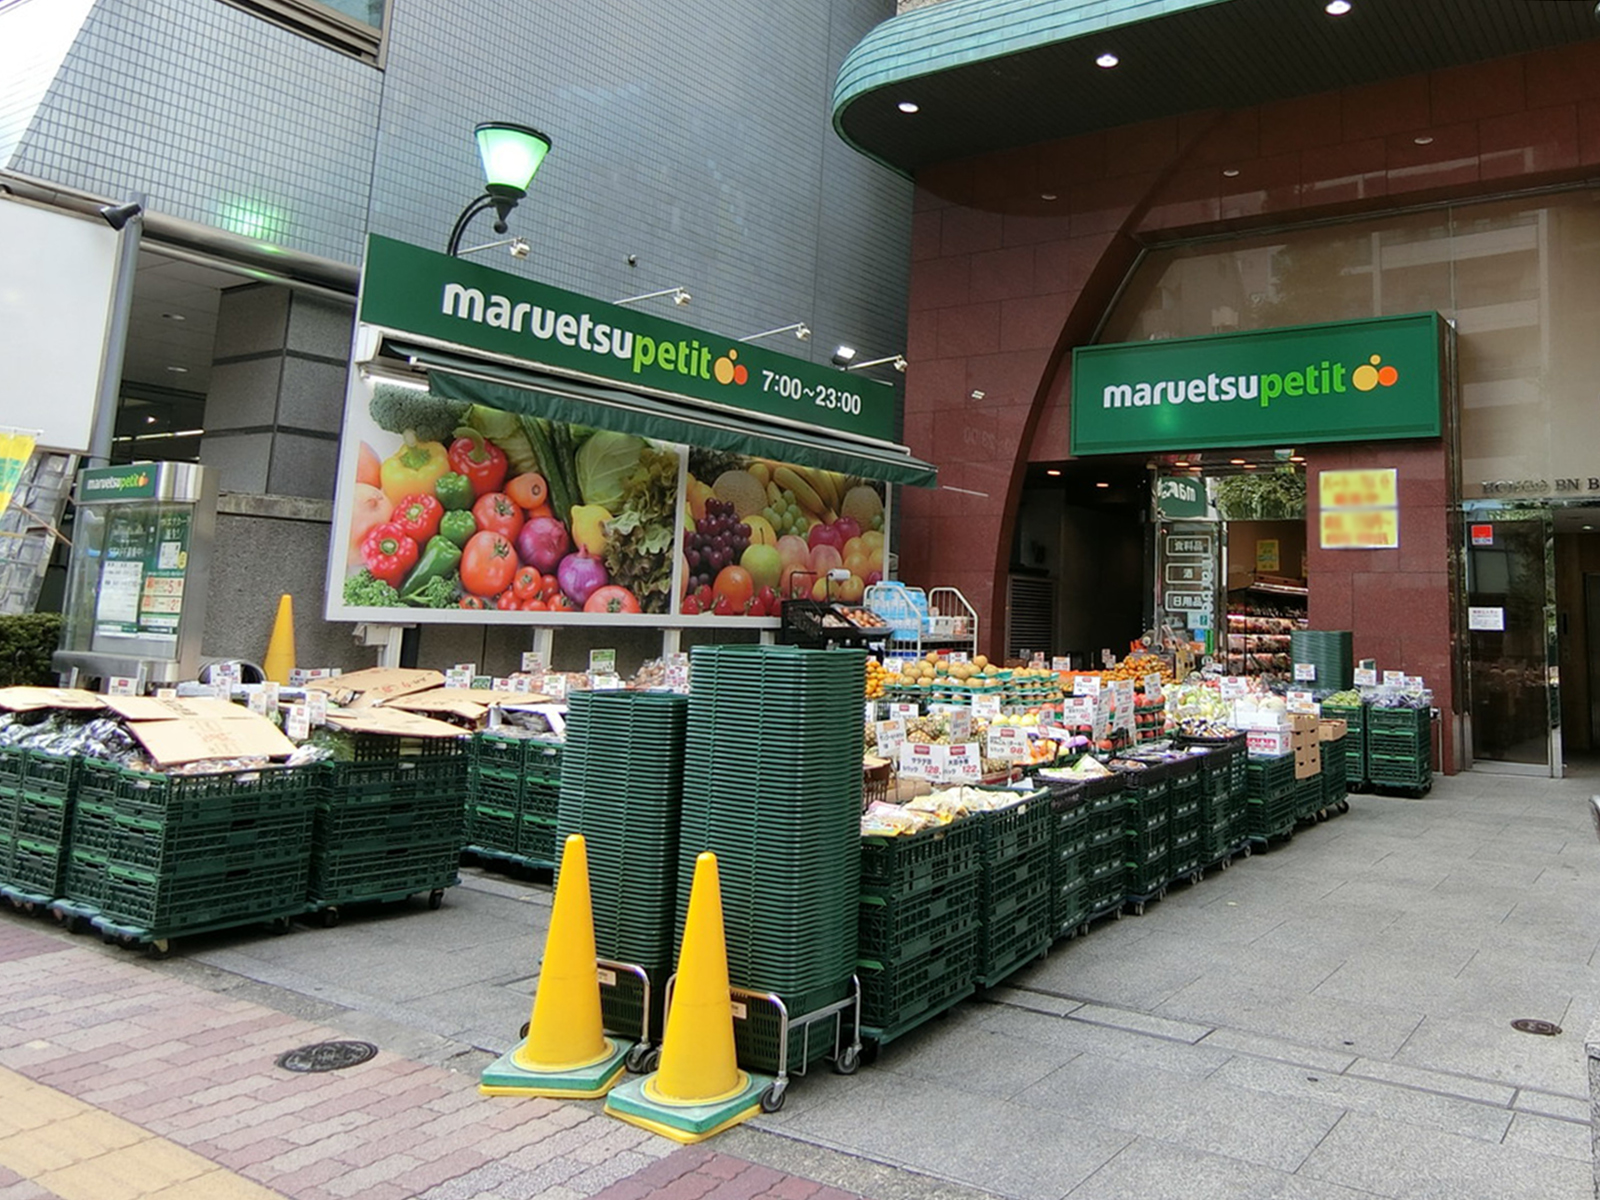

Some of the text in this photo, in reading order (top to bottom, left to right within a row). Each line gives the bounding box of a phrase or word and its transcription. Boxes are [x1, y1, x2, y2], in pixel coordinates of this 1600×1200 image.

[1555, 479, 1581, 491] BN
[1174, 540, 1203, 552] 食料品
[1173, 596, 1203, 607] 日用品
